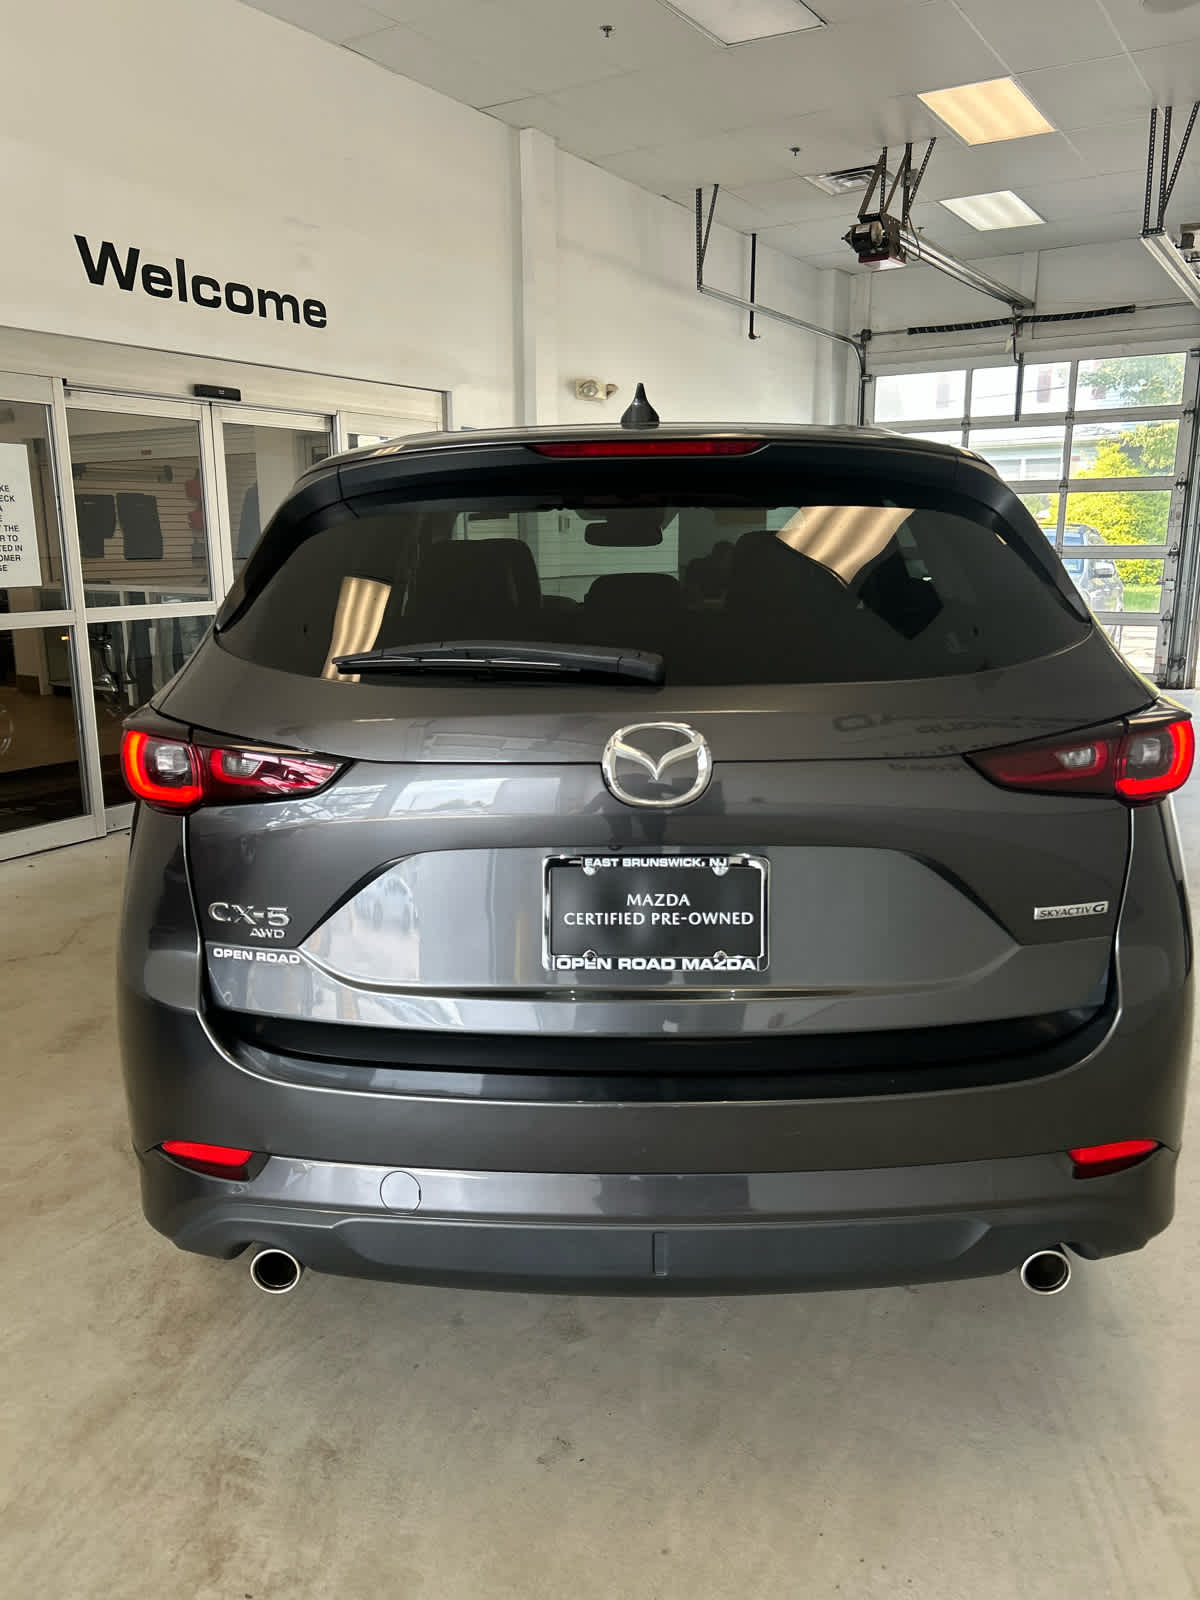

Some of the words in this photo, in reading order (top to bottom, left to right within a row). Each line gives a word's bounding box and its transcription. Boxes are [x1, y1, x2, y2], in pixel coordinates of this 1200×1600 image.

[74, 234, 327, 328] Welcome
[584, 858, 619, 867] EAST
[622, 858, 706, 867] BRUNSWICK,
[709, 858, 728, 867] NJ
[626, 893, 691, 907] MAZDA
[208, 902, 290, 926] CX-5
[563, 912, 645, 925] CERTIFIED
[651, 912, 754, 925] PRE-OWNED
[249, 928, 285, 939] AWD
[213, 947, 253, 960] OPEN
[255, 951, 301, 964] ROAD
[556, 957, 613, 970] OPEN
[618, 957, 676, 970] ROAD
[681, 957, 756, 970] MAZDA
